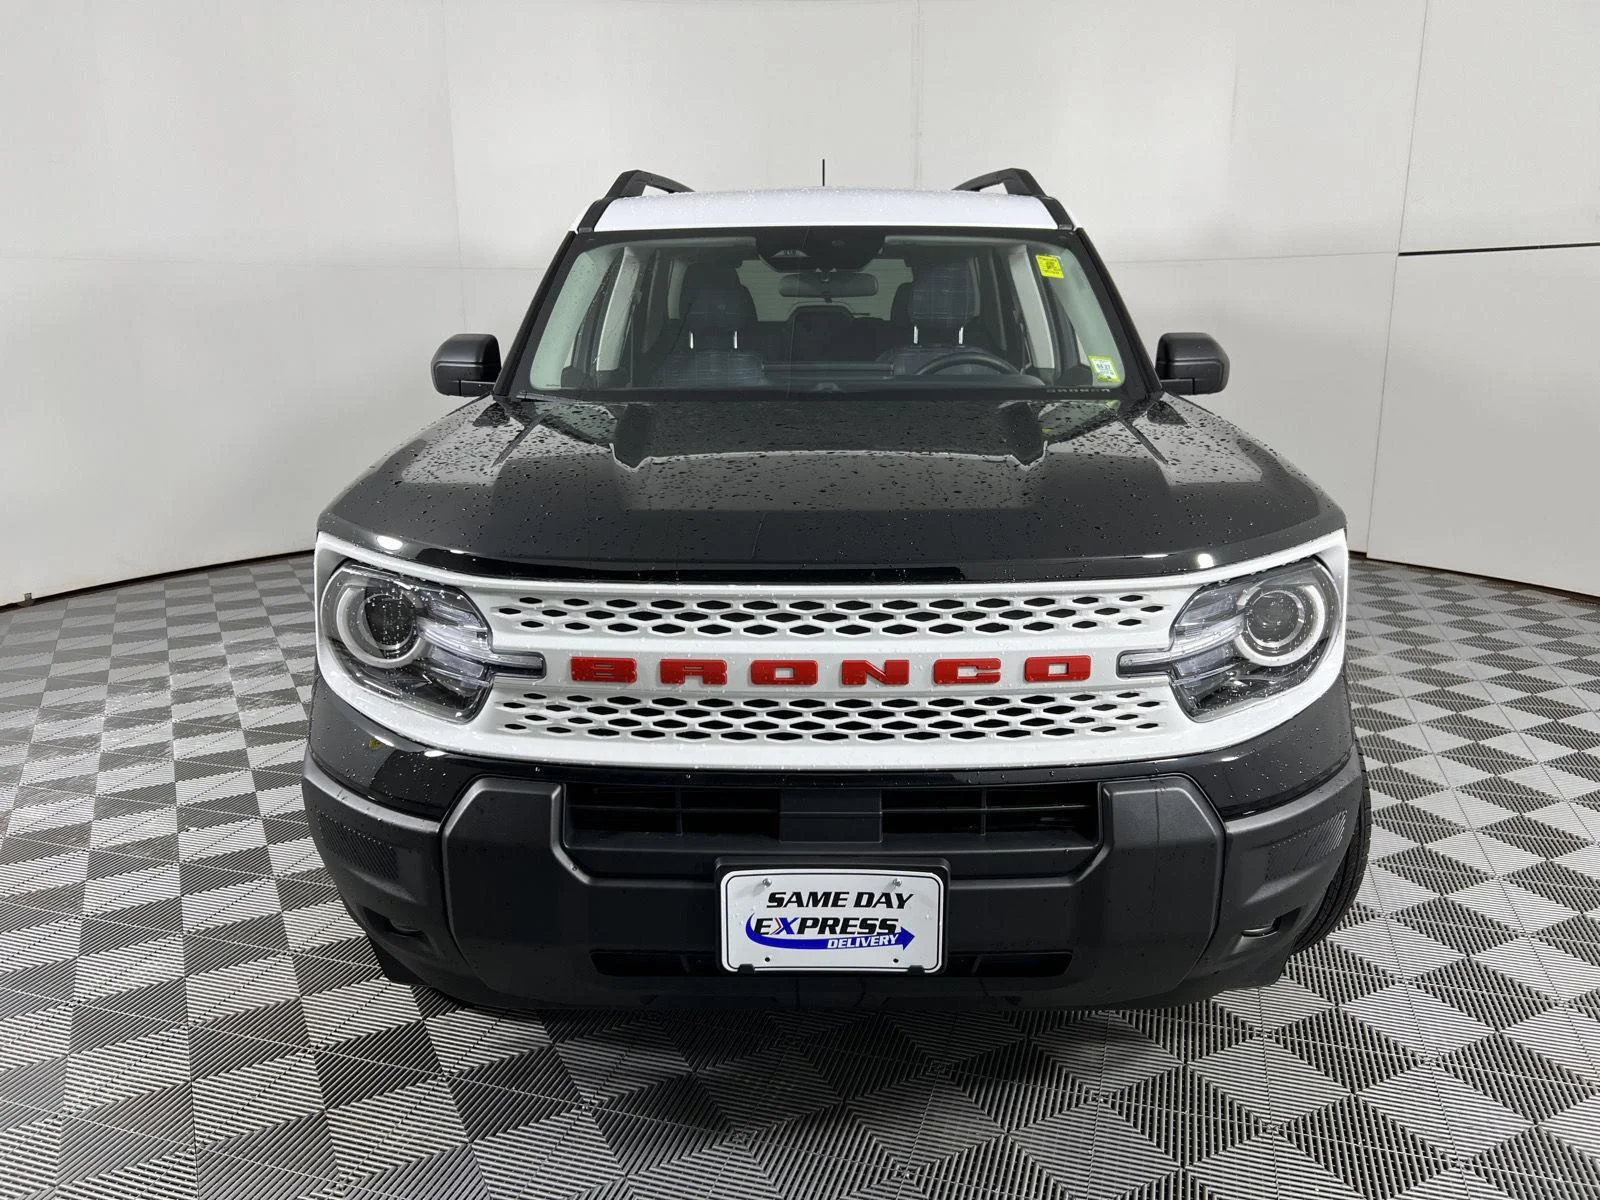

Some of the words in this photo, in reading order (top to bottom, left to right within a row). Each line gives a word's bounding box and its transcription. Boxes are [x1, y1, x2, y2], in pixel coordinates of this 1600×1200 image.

[570, 655, 1092, 686] BRONCO
[766, 891, 849, 909] SAME
[853, 891, 915, 909] DAY
[754, 917, 900, 936] EXPRESS
[827, 933, 900, 950] DELIVERY
